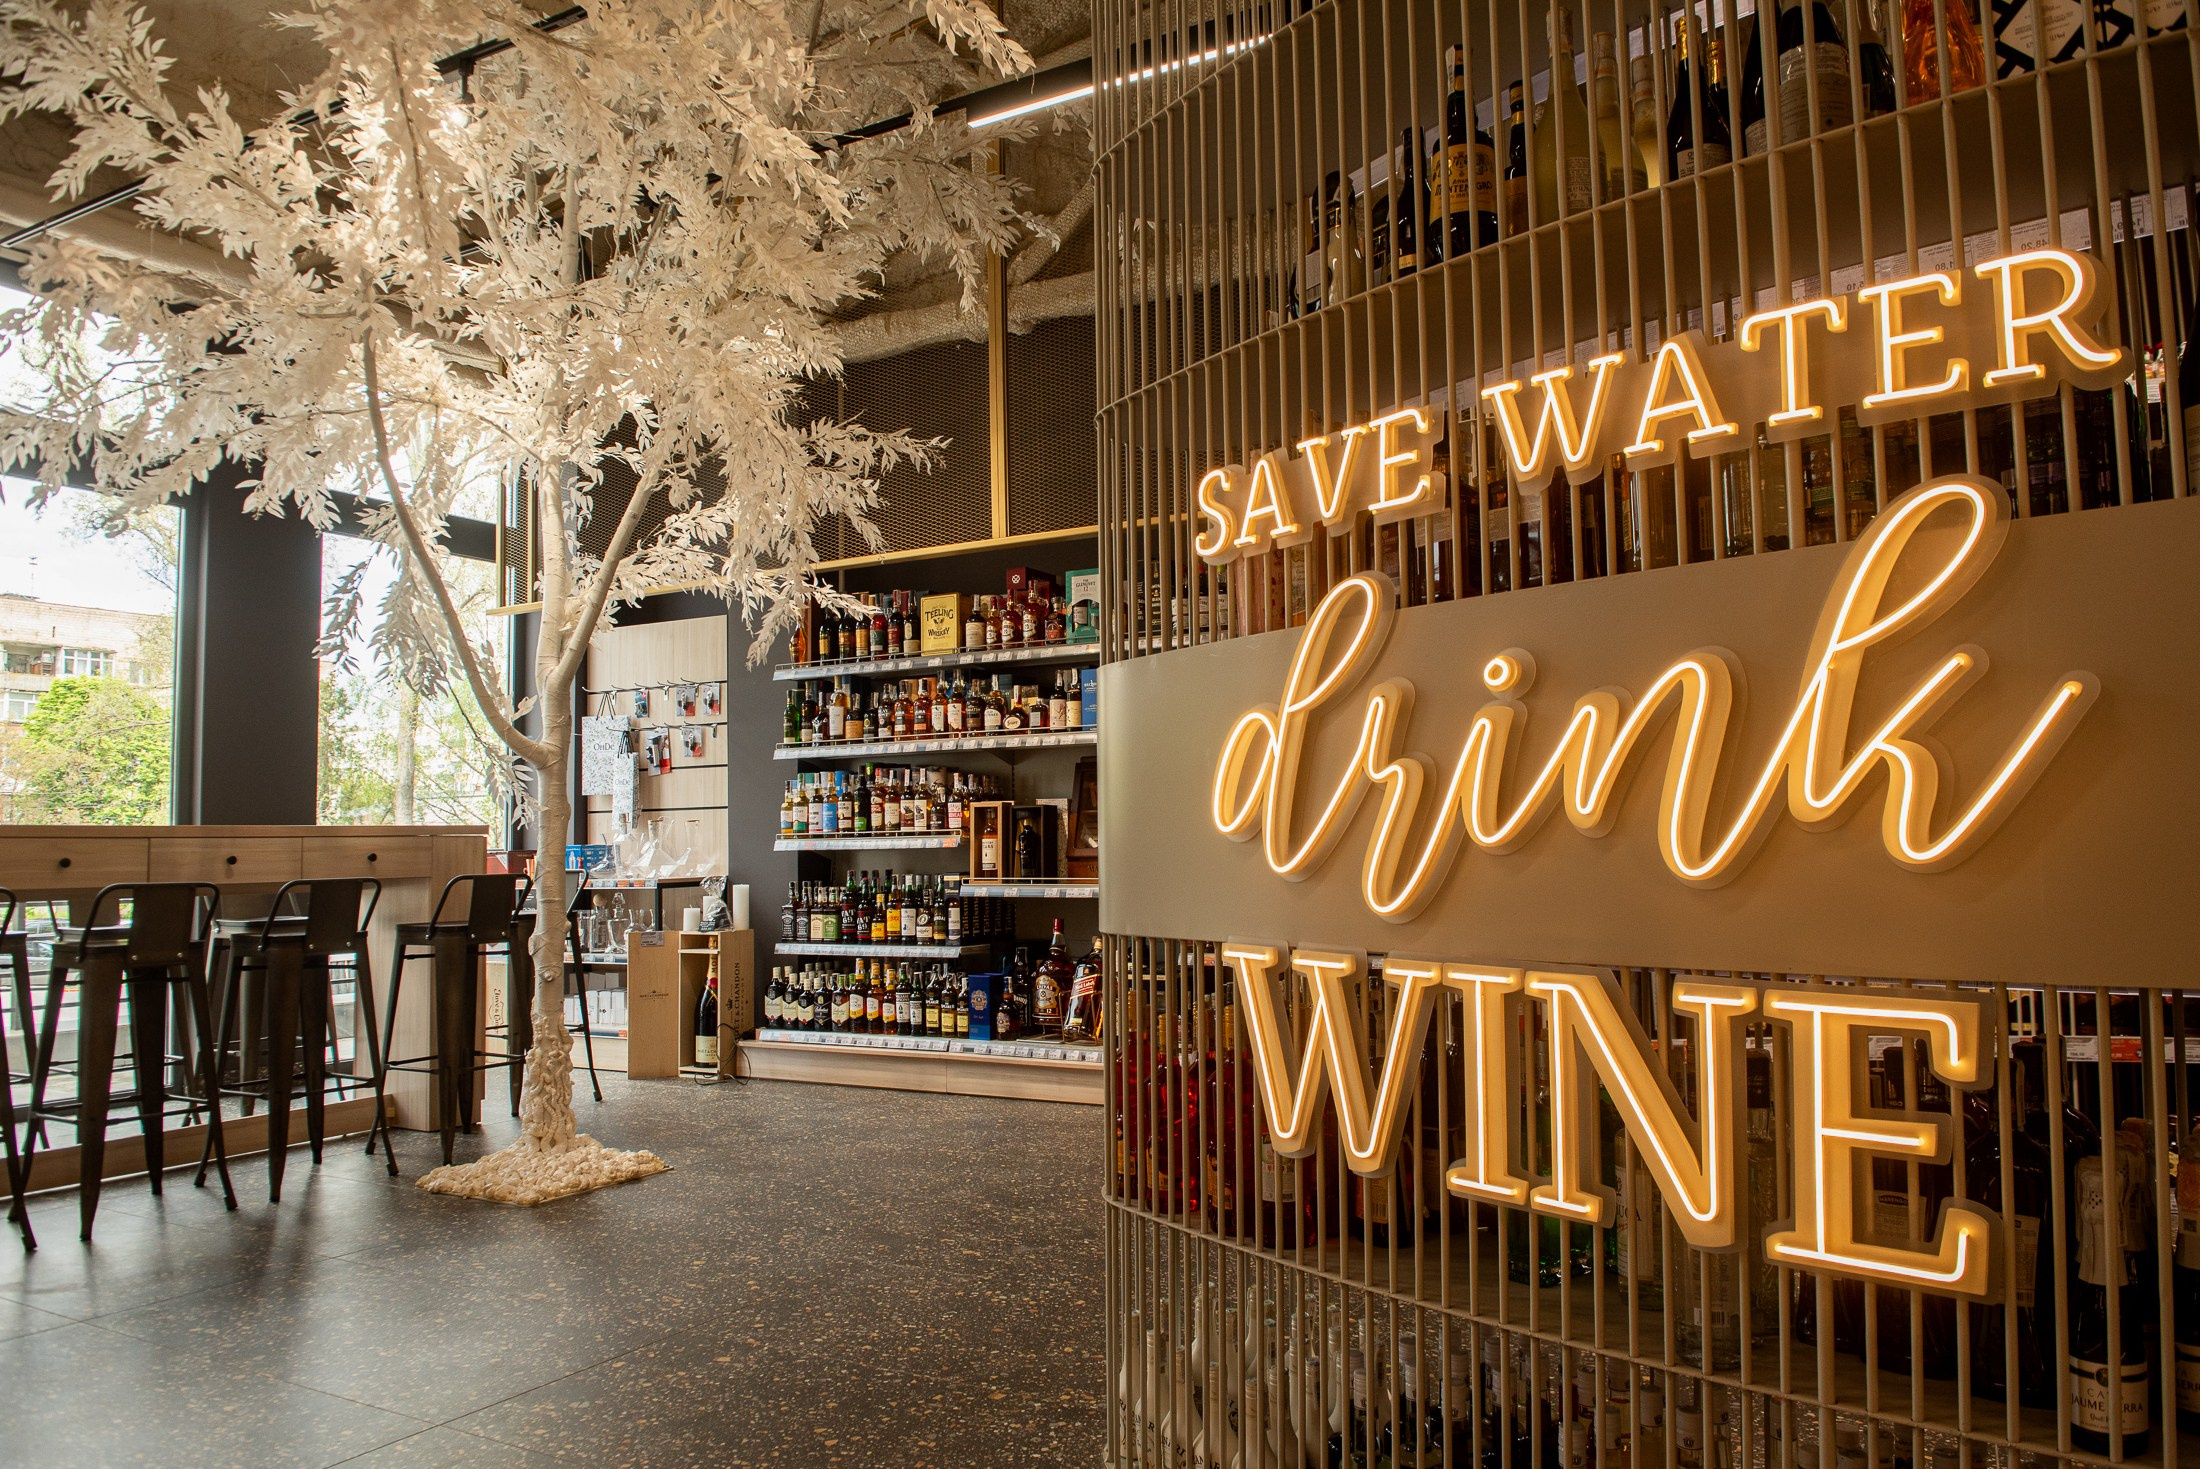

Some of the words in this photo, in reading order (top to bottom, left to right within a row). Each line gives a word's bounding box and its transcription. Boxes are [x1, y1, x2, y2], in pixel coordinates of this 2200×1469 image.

[1194, 404, 1436, 560] SAVE
[1480, 249, 2123, 477] WATER
[925, 608, 954, 622] TEELING
[1211, 483, 2083, 918] drink
[1221, 942, 1990, 1297] WINE
